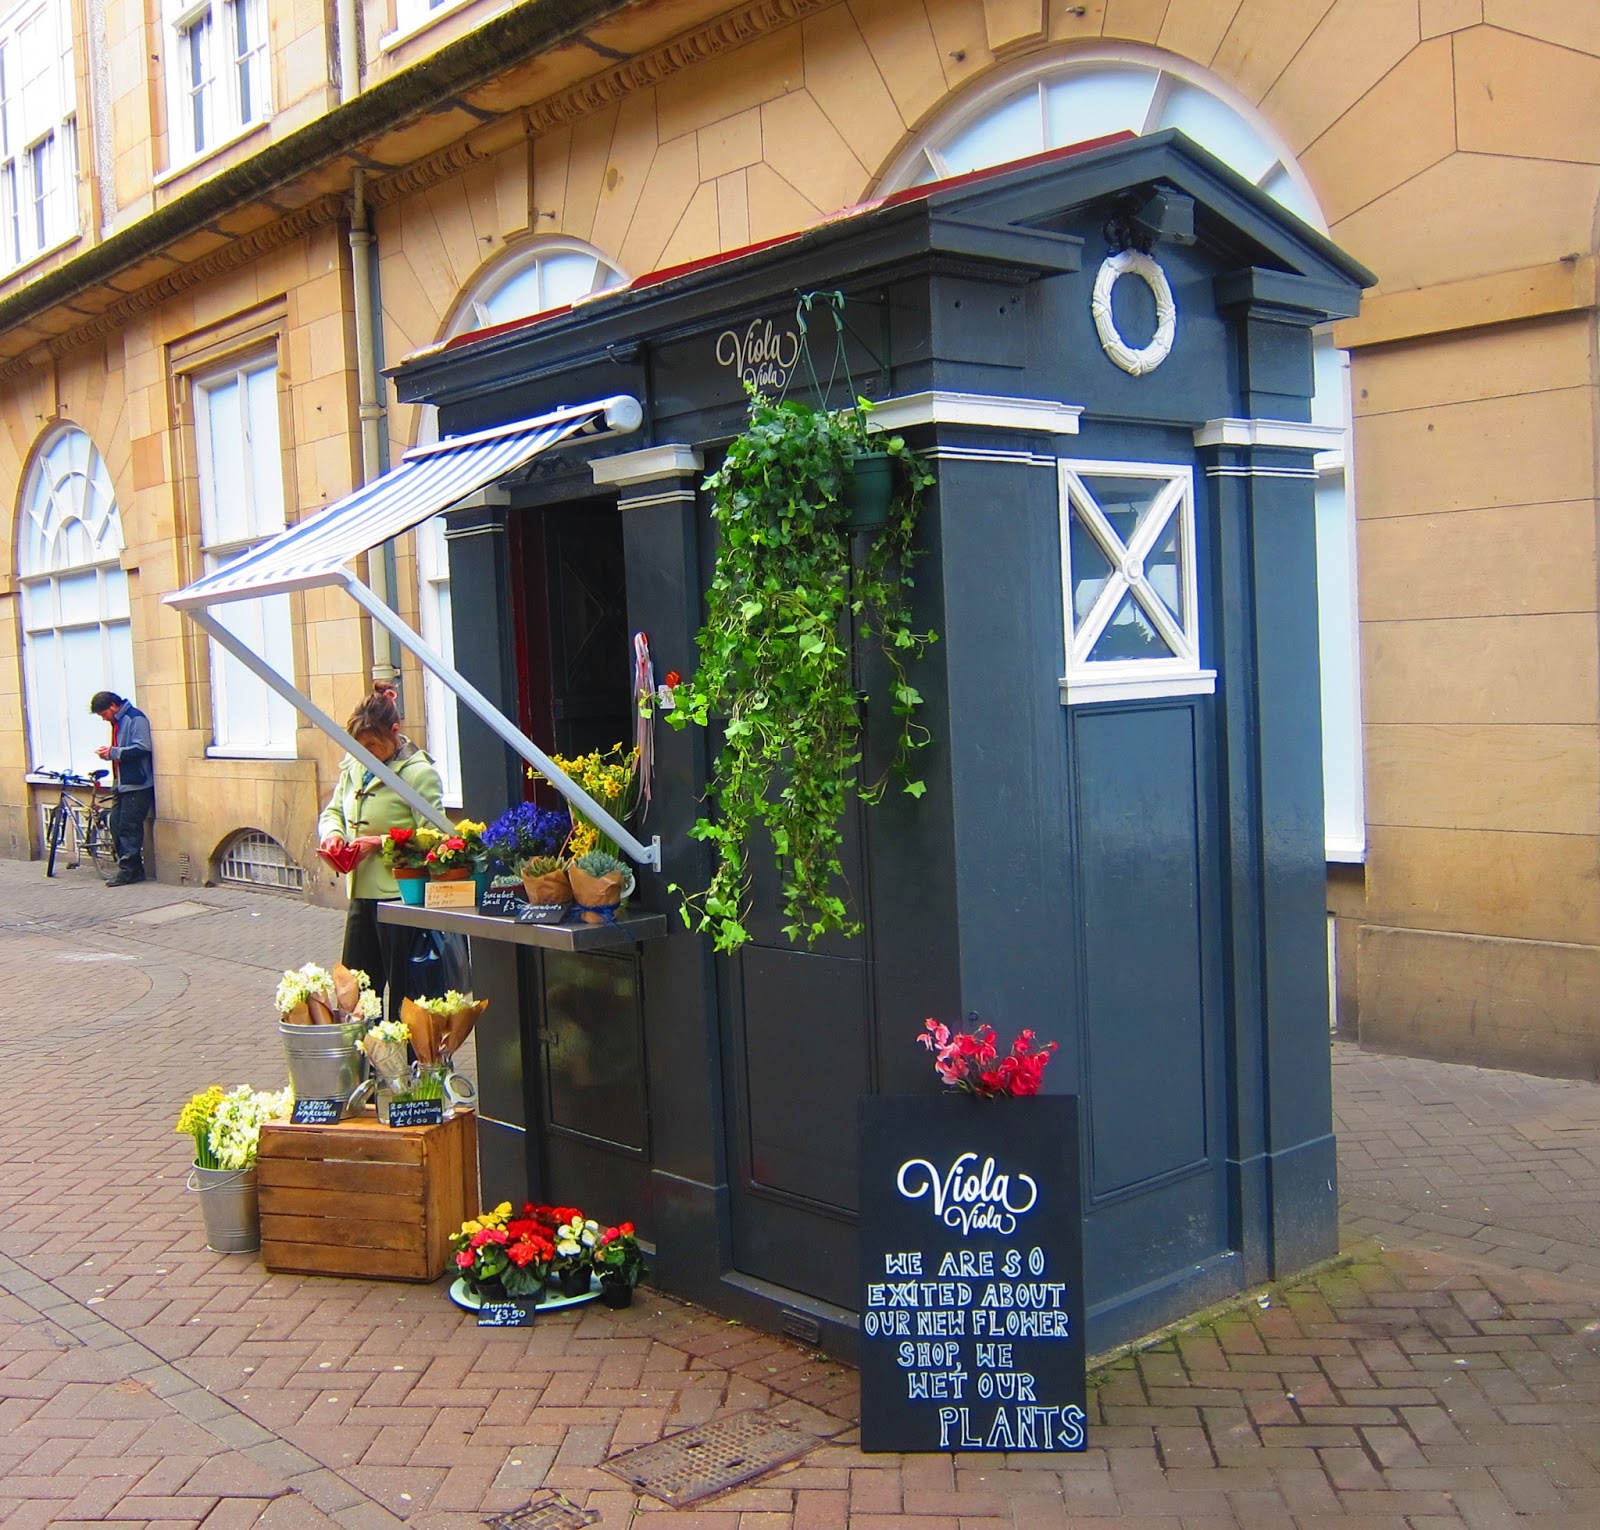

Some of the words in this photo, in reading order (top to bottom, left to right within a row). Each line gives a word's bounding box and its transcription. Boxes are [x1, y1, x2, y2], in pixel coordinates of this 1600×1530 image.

[716, 319, 798, 378] Viola
[742, 362, 786, 392] Viola
[897, 1152, 1037, 1215] Viola
[944, 1203, 1016, 1235] Viola
[885, 1252, 922, 1276] WE
[938, 1250, 994, 1277] ARE
[981, 1283, 1065, 1308] ABOUT
[865, 1311, 910, 1336] OUR
[917, 1311, 965, 1336] NEW
[972, 1311, 1068, 1337] FLOWER
[898, 1342, 962, 1373] SHOP,
[976, 1343, 1013, 1368] WE
[908, 1373, 967, 1399] WET
[977, 1373, 1037, 1401] OUR
[939, 1404, 1084, 1449] PLANTS
